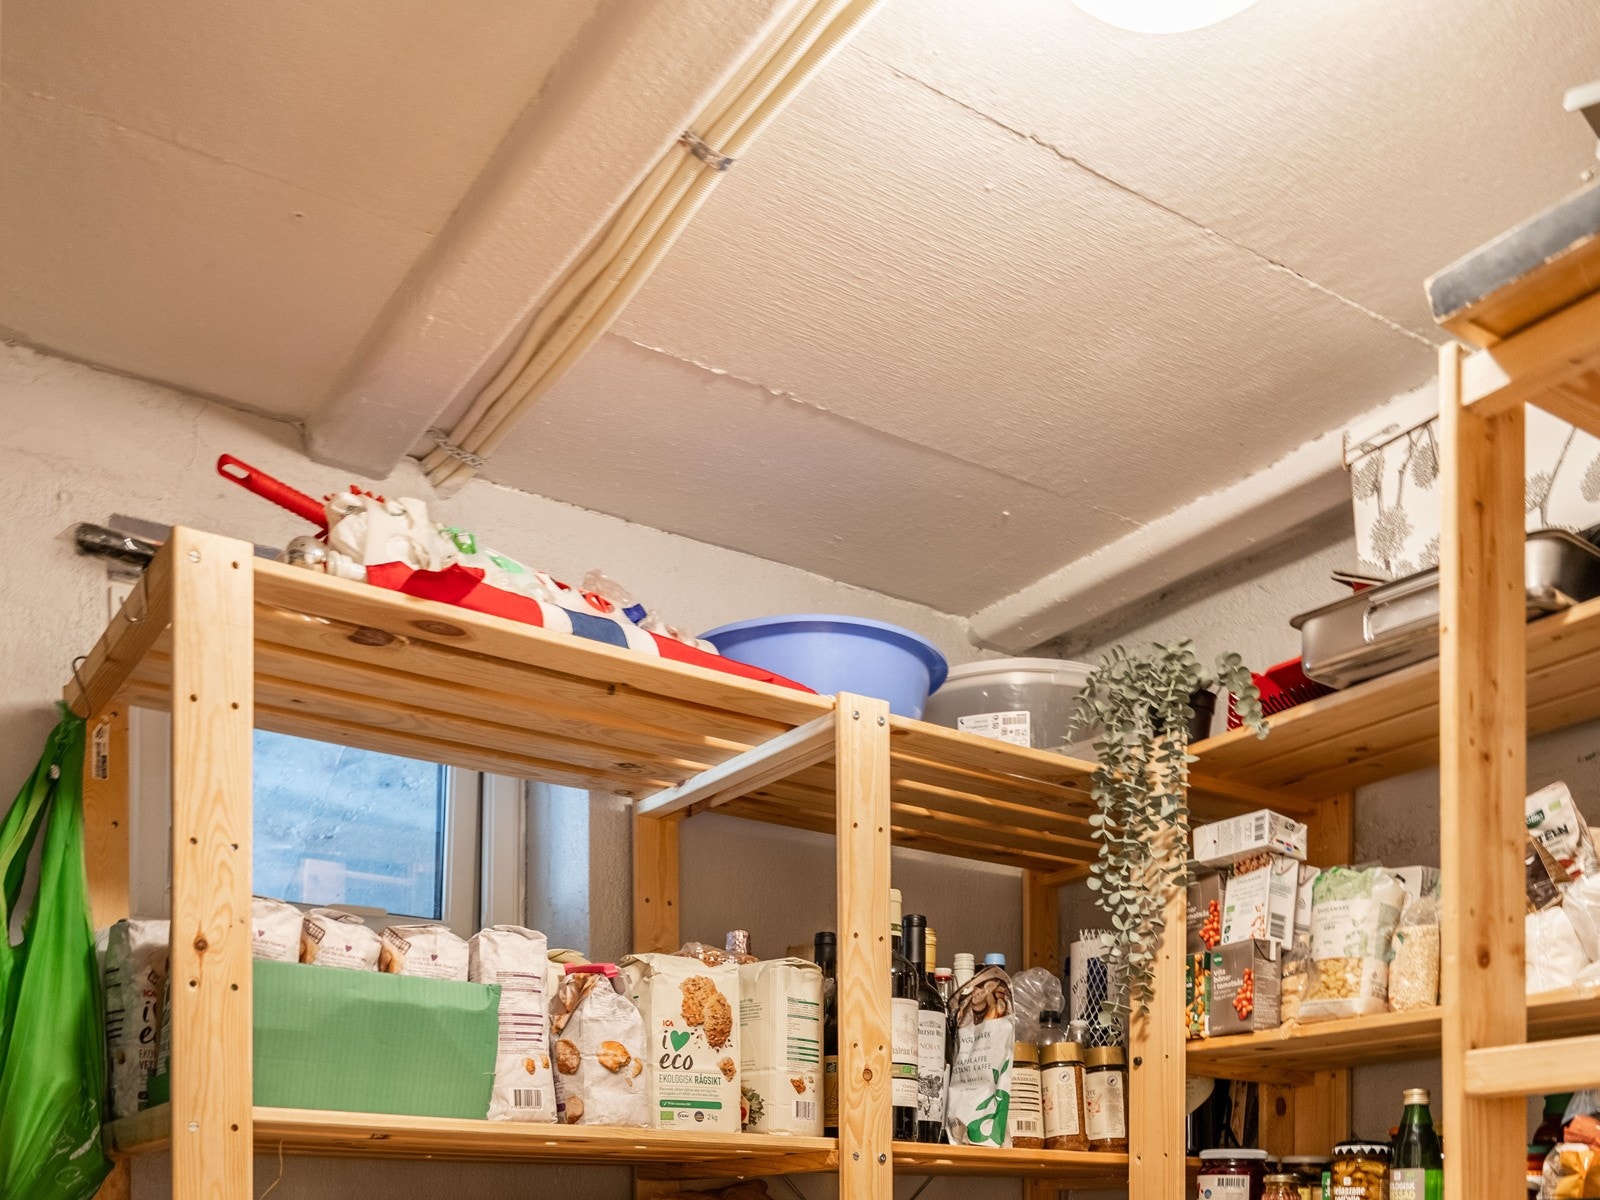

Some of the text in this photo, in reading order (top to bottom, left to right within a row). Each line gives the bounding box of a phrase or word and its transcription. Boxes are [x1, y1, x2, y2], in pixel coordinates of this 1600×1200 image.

[660, 1053, 694, 1071] eco
[659, 1074, 693, 1084] EKOLOGISK
[694, 1073, 721, 1086] RÅGSIKT
